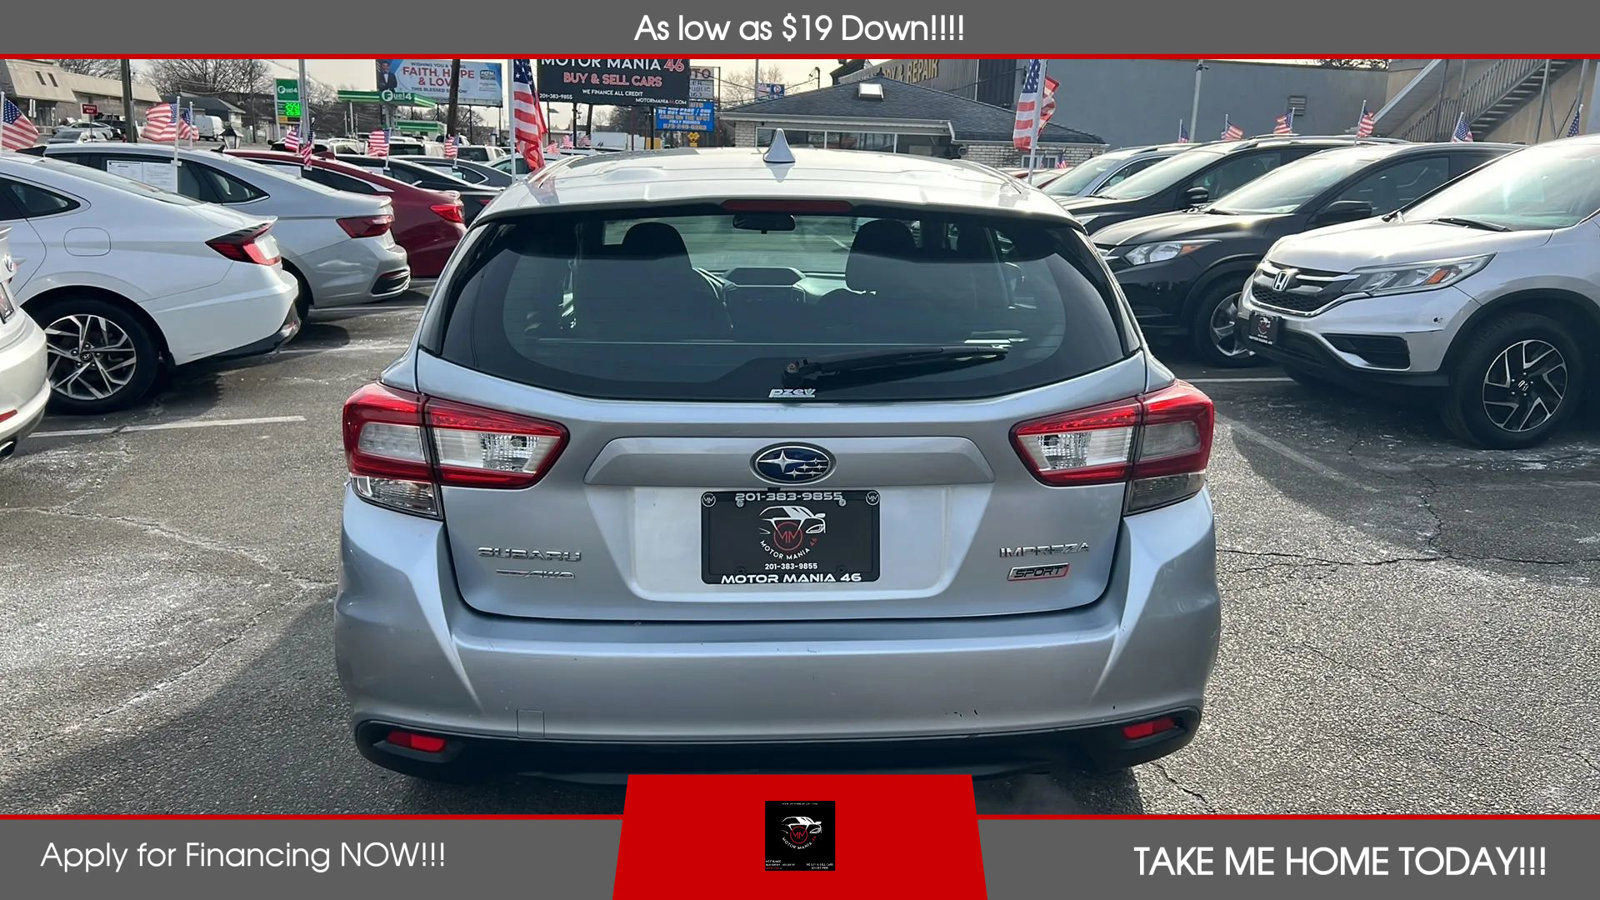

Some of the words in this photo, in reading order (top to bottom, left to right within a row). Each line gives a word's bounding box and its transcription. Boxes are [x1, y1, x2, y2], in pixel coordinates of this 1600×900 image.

[541, 59, 601, 68] MOTOR
[607, 59, 661, 71] MANIA
[664, 59, 685, 73] 46
[906, 59, 939, 84] REPAIR
[442, 69, 475, 79] HPE
[563, 72, 589, 84] BUY
[591, 73, 600, 84] &
[602, 74, 630, 85] SELL
[631, 75, 662, 88] CARS
[418, 77, 426, 86] &
[429, 78, 452, 87] LOV
[735, 492, 843, 501] 201-383-9855
[478, 546, 582, 562] SUBARU
[760, 540, 783, 559] MOTOR
[786, 548, 810, 560] MANIA
[999, 542, 1089, 558] IMPREZA
[765, 562, 818, 570] 201-383-9855
[1013, 566, 1063, 578] SPORT
[721, 574, 779, 584] MOTOR
[783, 574, 836, 583] MANIA
[840, 573, 862, 582] 46
